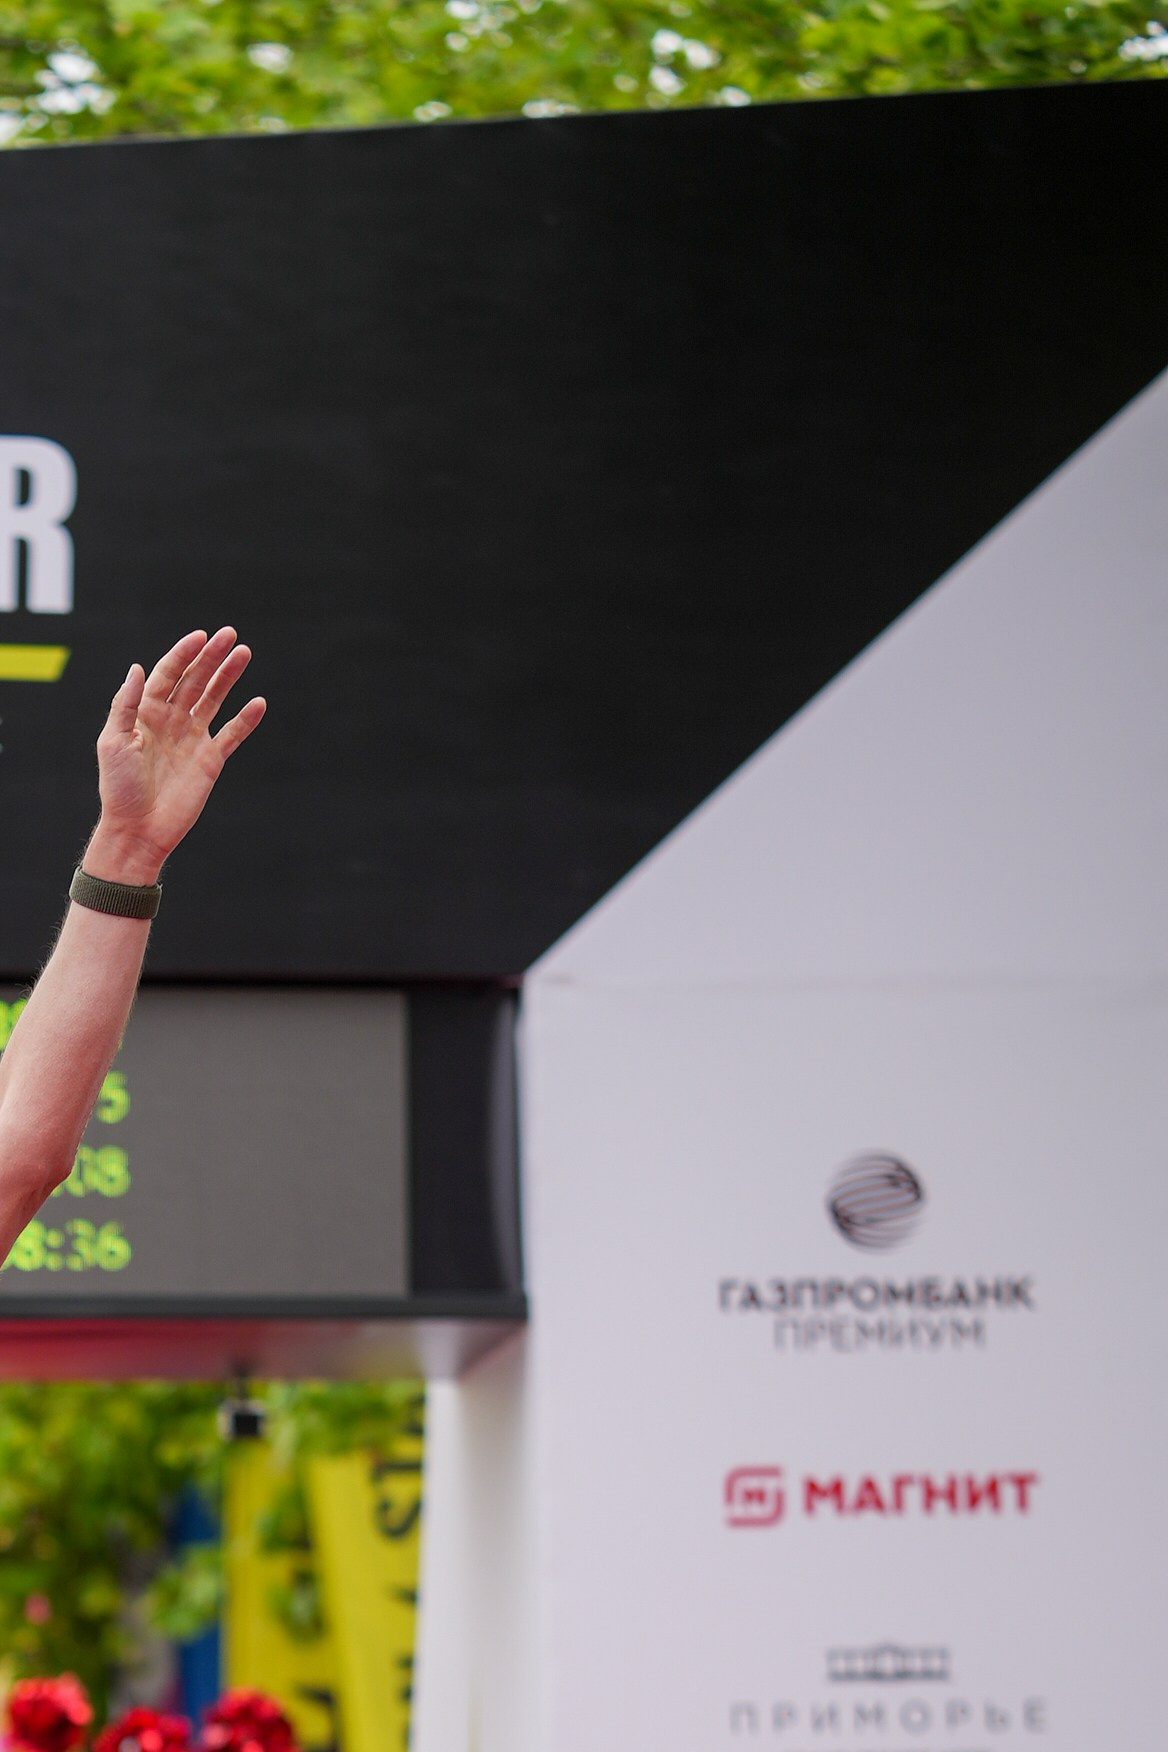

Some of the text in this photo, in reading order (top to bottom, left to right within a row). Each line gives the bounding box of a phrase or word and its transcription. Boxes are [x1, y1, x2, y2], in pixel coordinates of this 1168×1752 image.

[718, 1275, 1036, 1313] ГАЗПРОМБАНК
[774, 1314, 986, 1352] ПРЕМИУМ
[803, 1470, 1039, 1516] МАГНИТ
[730, 1697, 1049, 1736] ПРИМОРЬЕ
